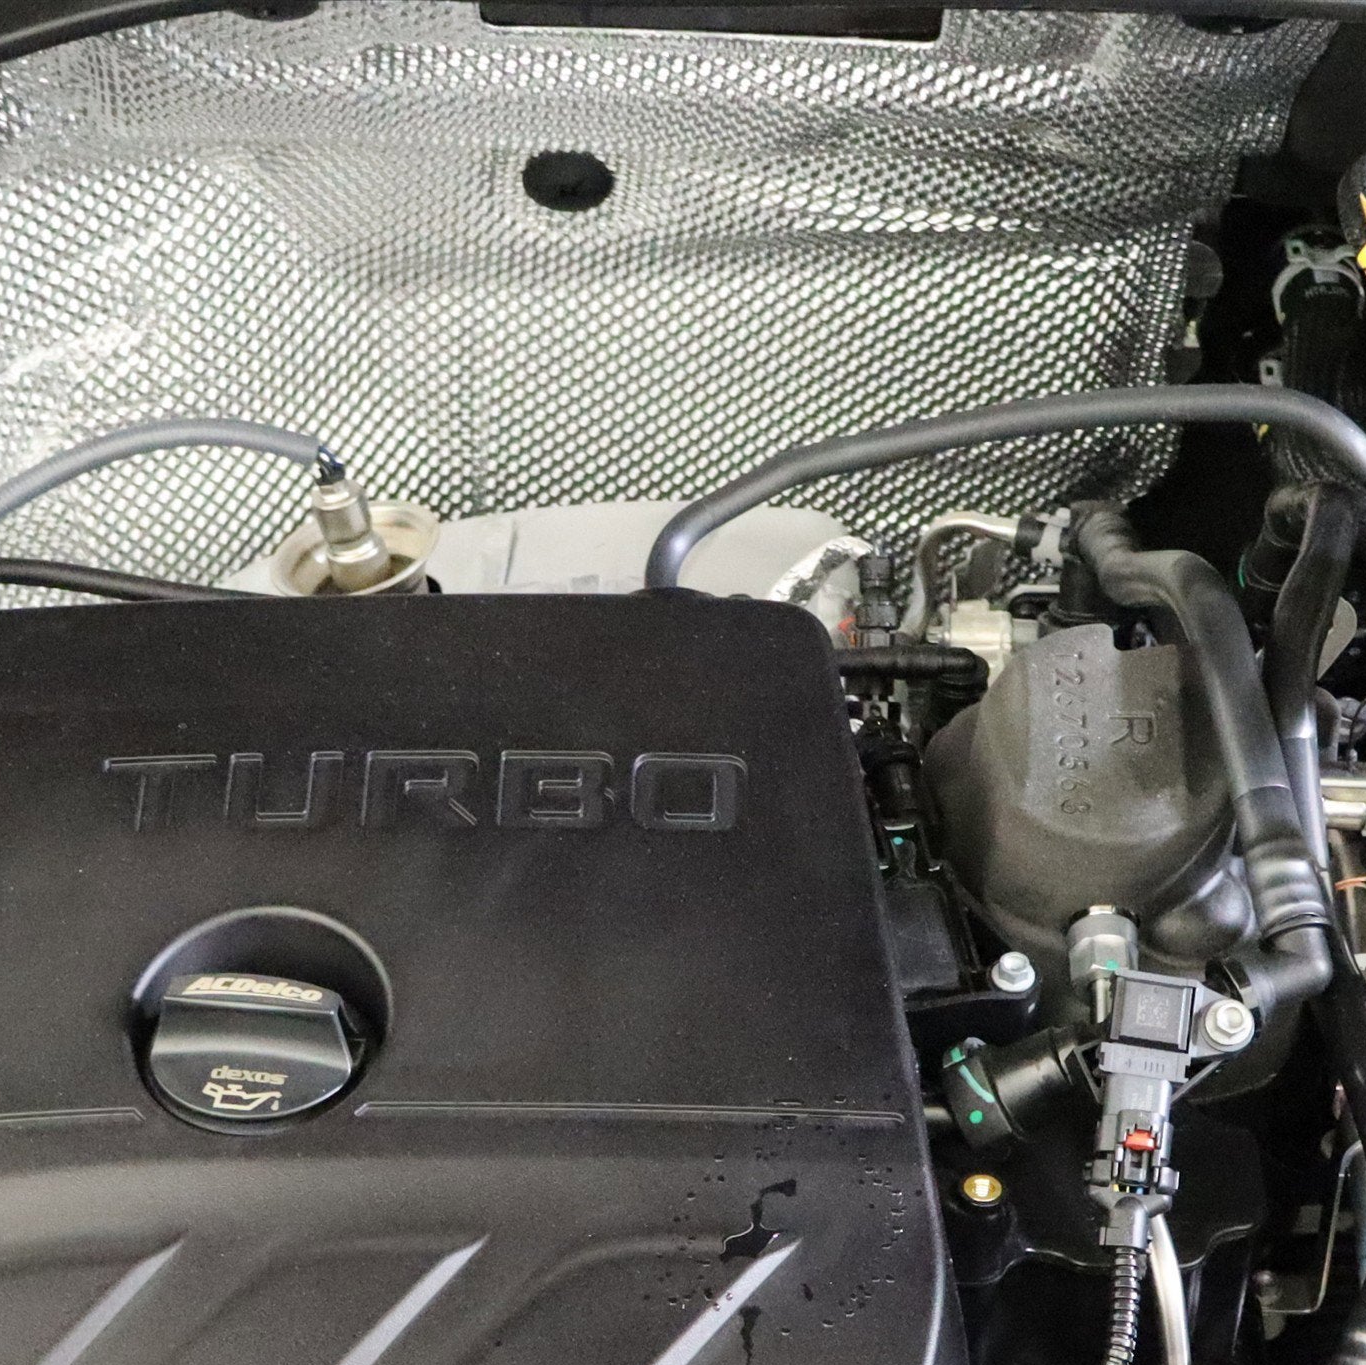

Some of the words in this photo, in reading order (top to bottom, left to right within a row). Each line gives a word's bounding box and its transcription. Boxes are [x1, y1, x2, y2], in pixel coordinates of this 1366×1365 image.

[103, 750, 748, 830] TURBO
[187, 976, 323, 1003] ACDelco
[211, 1065, 288, 1085] dexos
